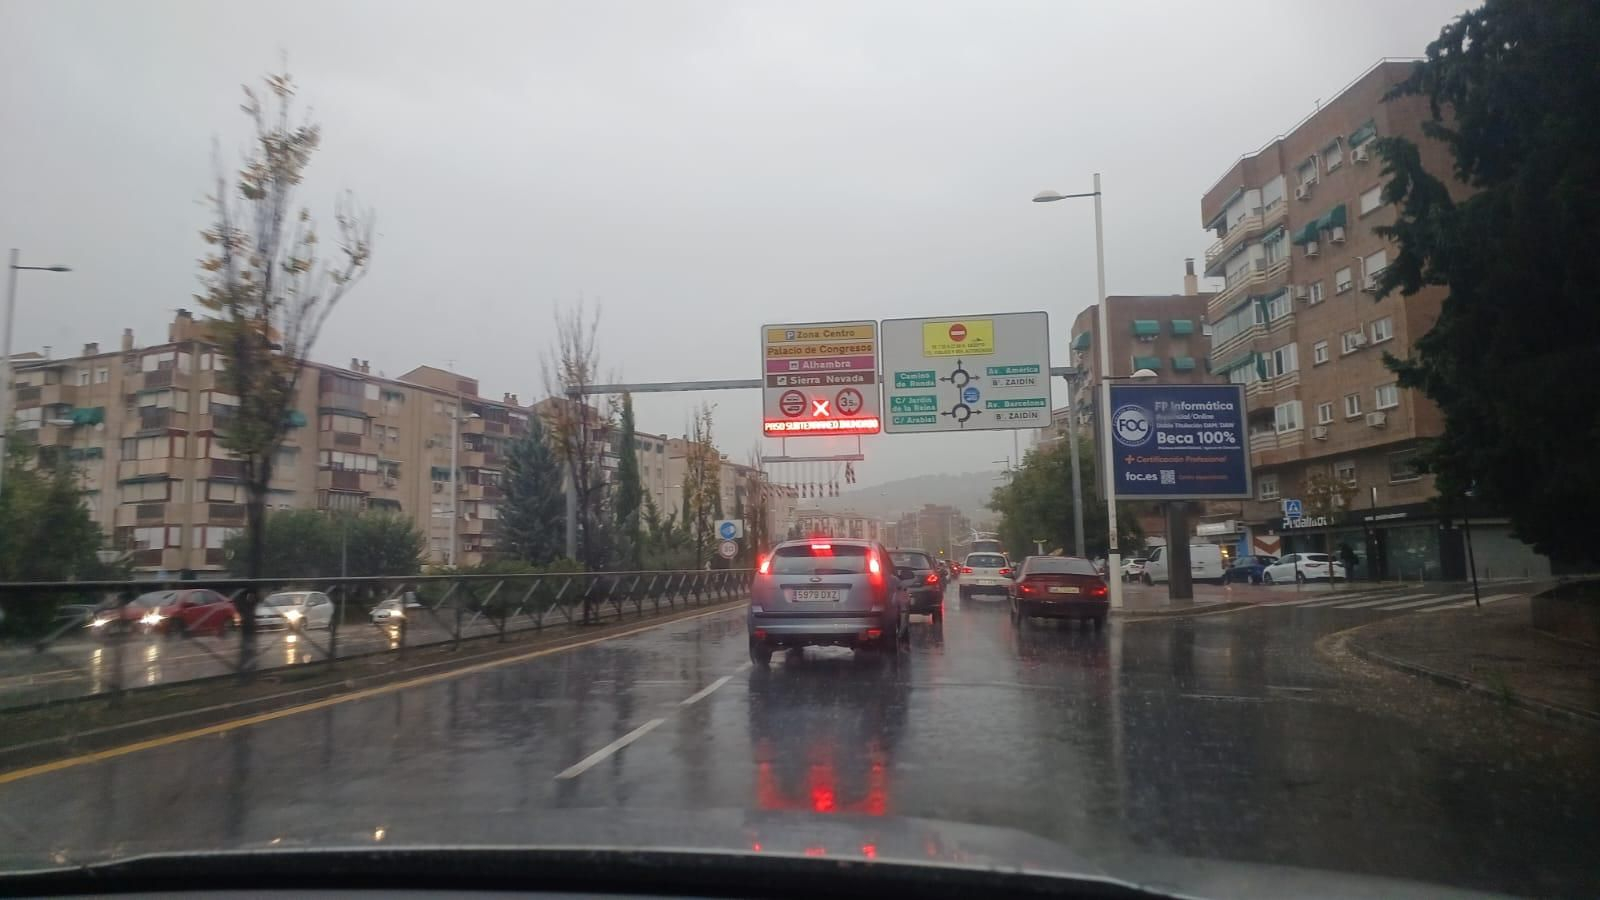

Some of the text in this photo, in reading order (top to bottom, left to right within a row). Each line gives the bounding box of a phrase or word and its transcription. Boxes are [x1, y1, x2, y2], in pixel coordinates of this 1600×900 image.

[797, 331, 820, 339] Zona
[823, 329, 855, 338] Centro
[768, 344, 872, 355] Palacio de Congresos
[802, 360, 851, 369] Alhambra
[790, 374, 864, 385] Sierra Nevada
[1155, 400, 1234, 411] FP Informática
[764, 422, 785, 431] PASO
[1119, 418, 1146, 432] FOC
[1156, 431, 1194, 444] Beca
[1197, 431, 1236, 444] 100%
[1125, 471, 1158, 481] foc.es
